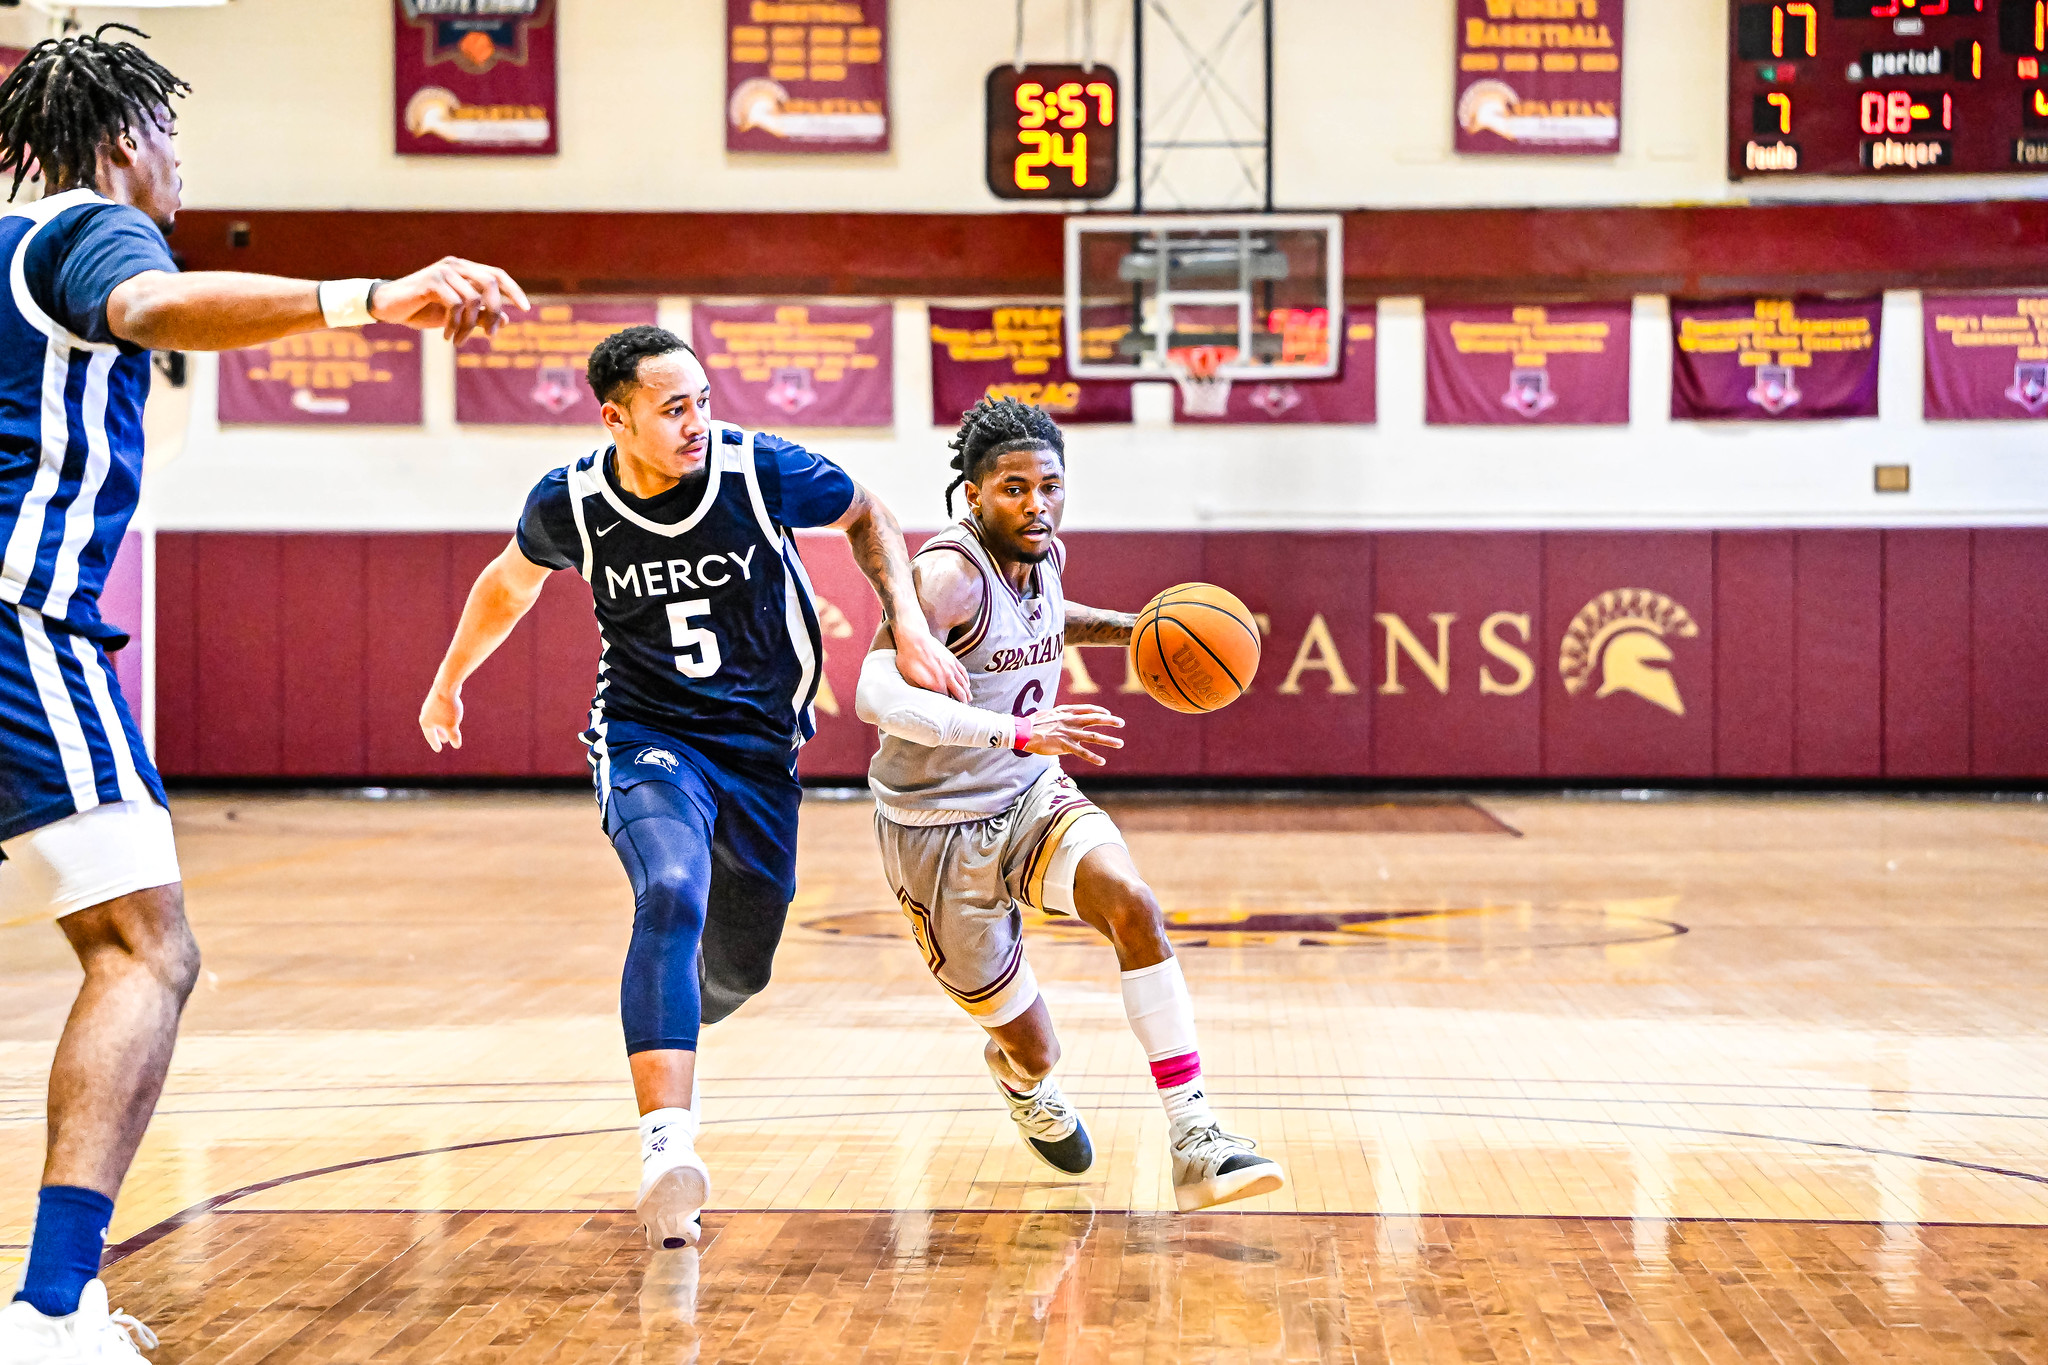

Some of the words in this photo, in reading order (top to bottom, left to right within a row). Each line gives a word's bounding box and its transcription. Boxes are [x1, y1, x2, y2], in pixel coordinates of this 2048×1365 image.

[1771, 3, 1817, 57] 17
[1871, 46, 1941, 78] period
[1972, 41, 1982, 80] 1
[1015, 82, 1114, 129] 5:57
[1767, 93, 1791, 134] 7
[1014, 129, 1088, 190] 24
[605, 544, 756, 599] MERCY
[665, 598, 722, 678] 5
